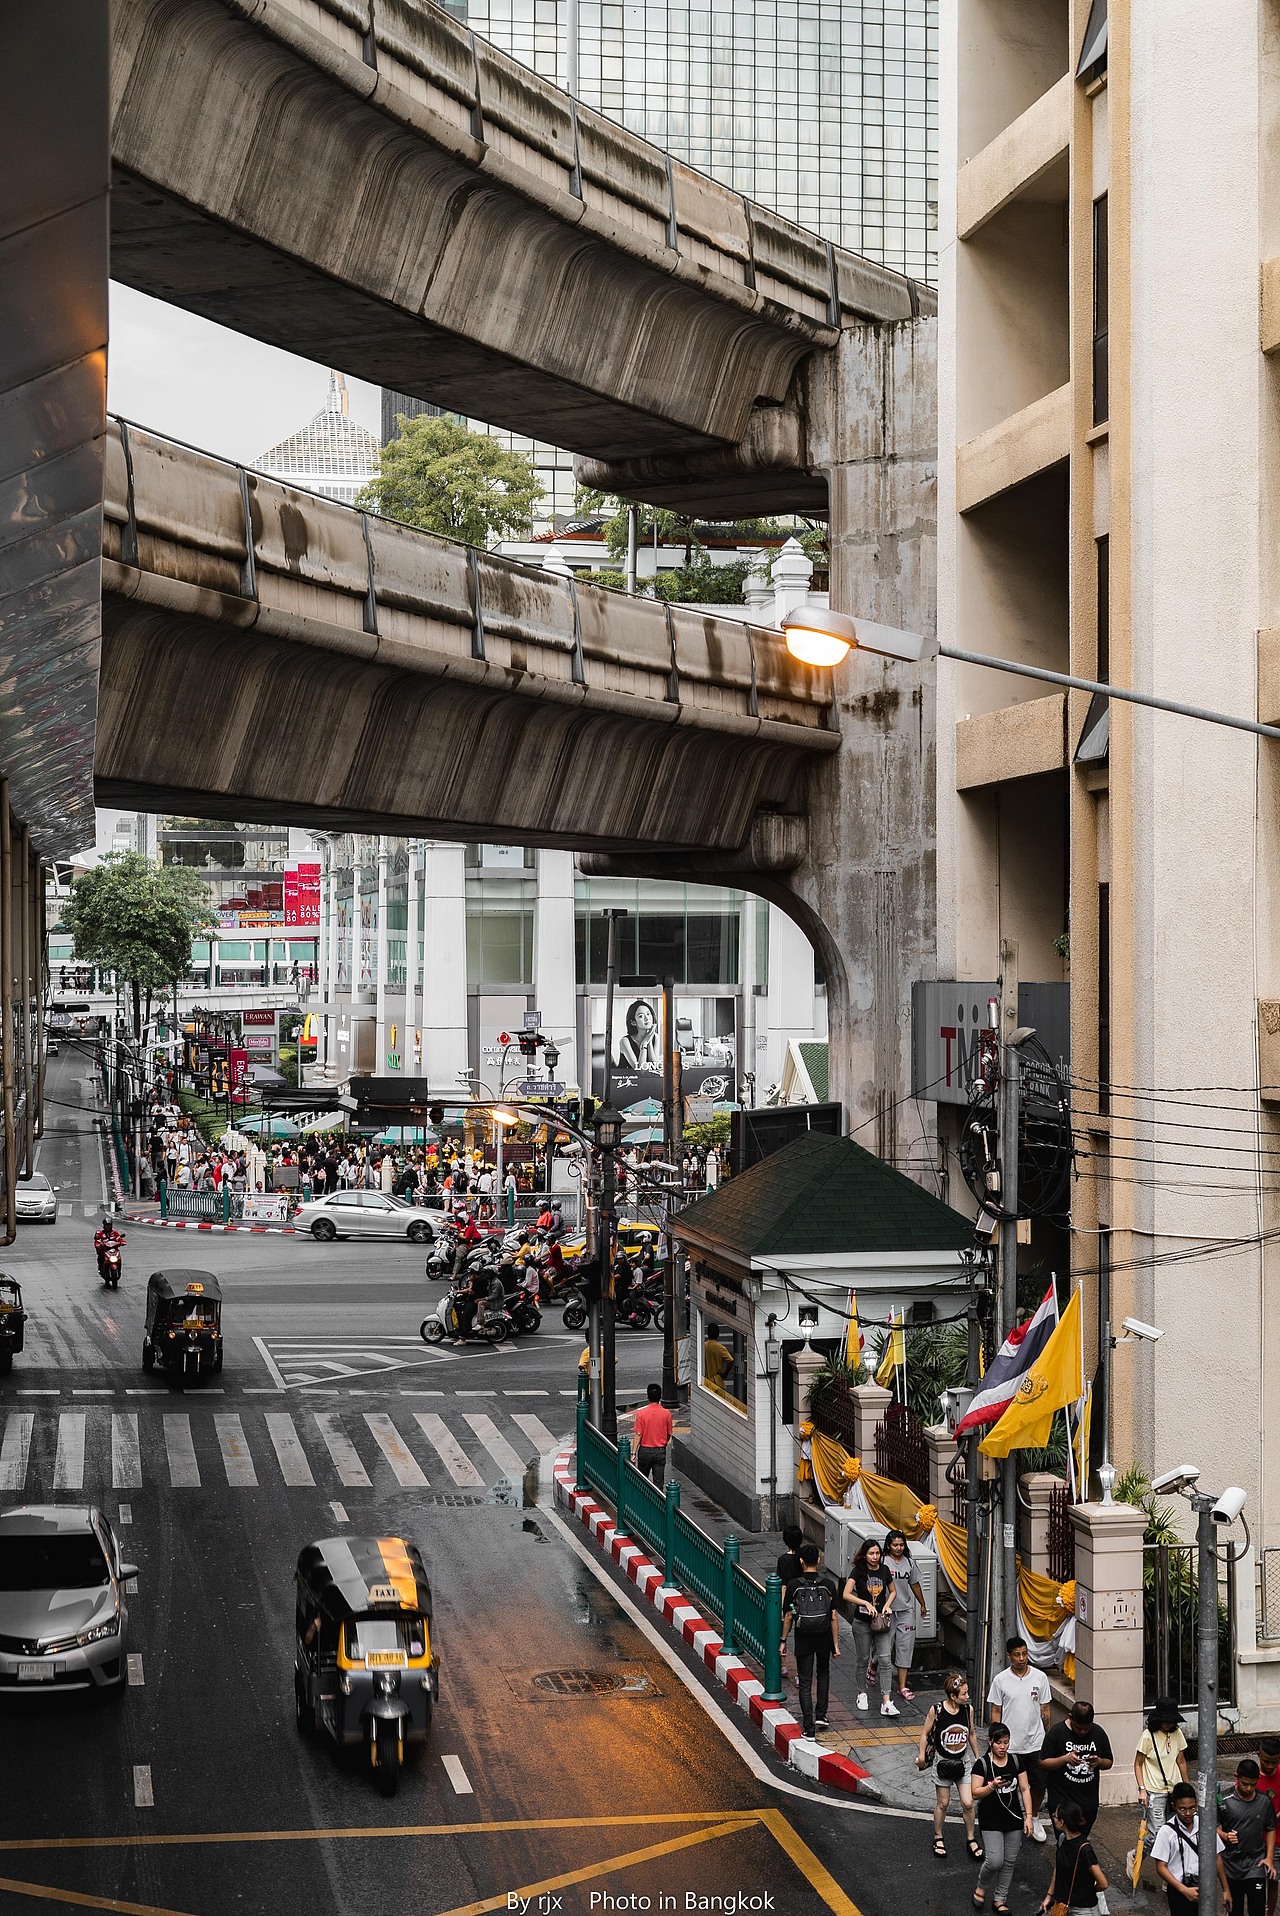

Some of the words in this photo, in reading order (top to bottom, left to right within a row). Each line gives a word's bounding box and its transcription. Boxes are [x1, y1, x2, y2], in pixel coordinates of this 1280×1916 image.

[245, 1012, 273, 1020] ERAWAN
[634, 1061, 690, 1071] LONGS
[375, 1588, 395, 1597] TAXI
[1065, 1741, 1097, 1752] SINGHA
